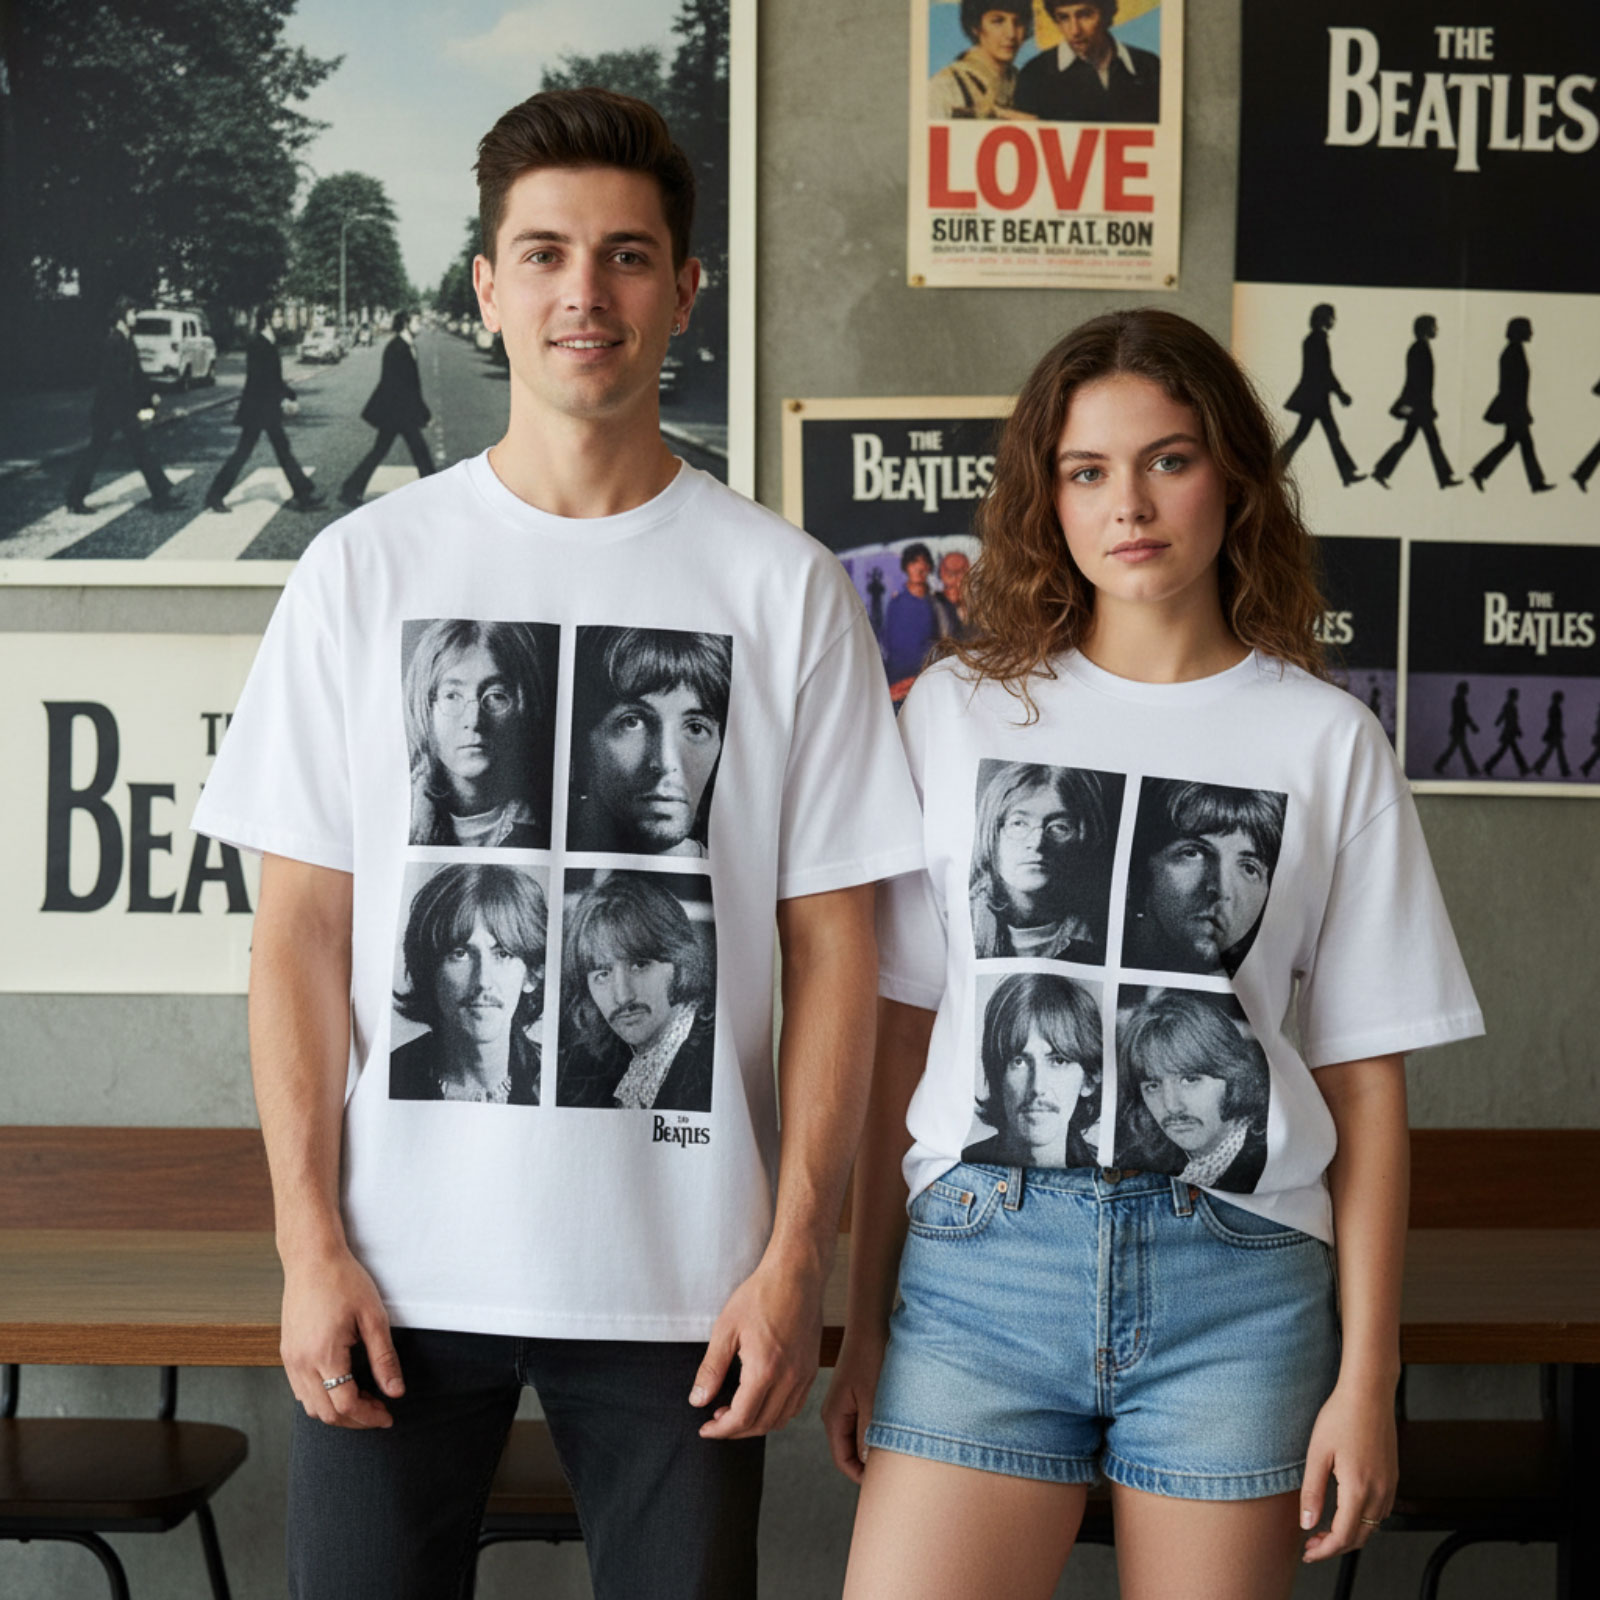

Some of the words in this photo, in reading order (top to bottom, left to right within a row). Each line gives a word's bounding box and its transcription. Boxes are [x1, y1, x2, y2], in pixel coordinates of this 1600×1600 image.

[1434, 26, 1494, 60] THE
[1325, 27, 1599, 172] BEATLES
[928, 125, 1154, 212] LOVE
[1002, 219, 1065, 245] BEAT
[1107, 221, 1153, 246] BON
[908, 431, 943, 450] THE
[852, 433, 997, 512] BEATLES
[1484, 592, 1596, 655] BEATLES
